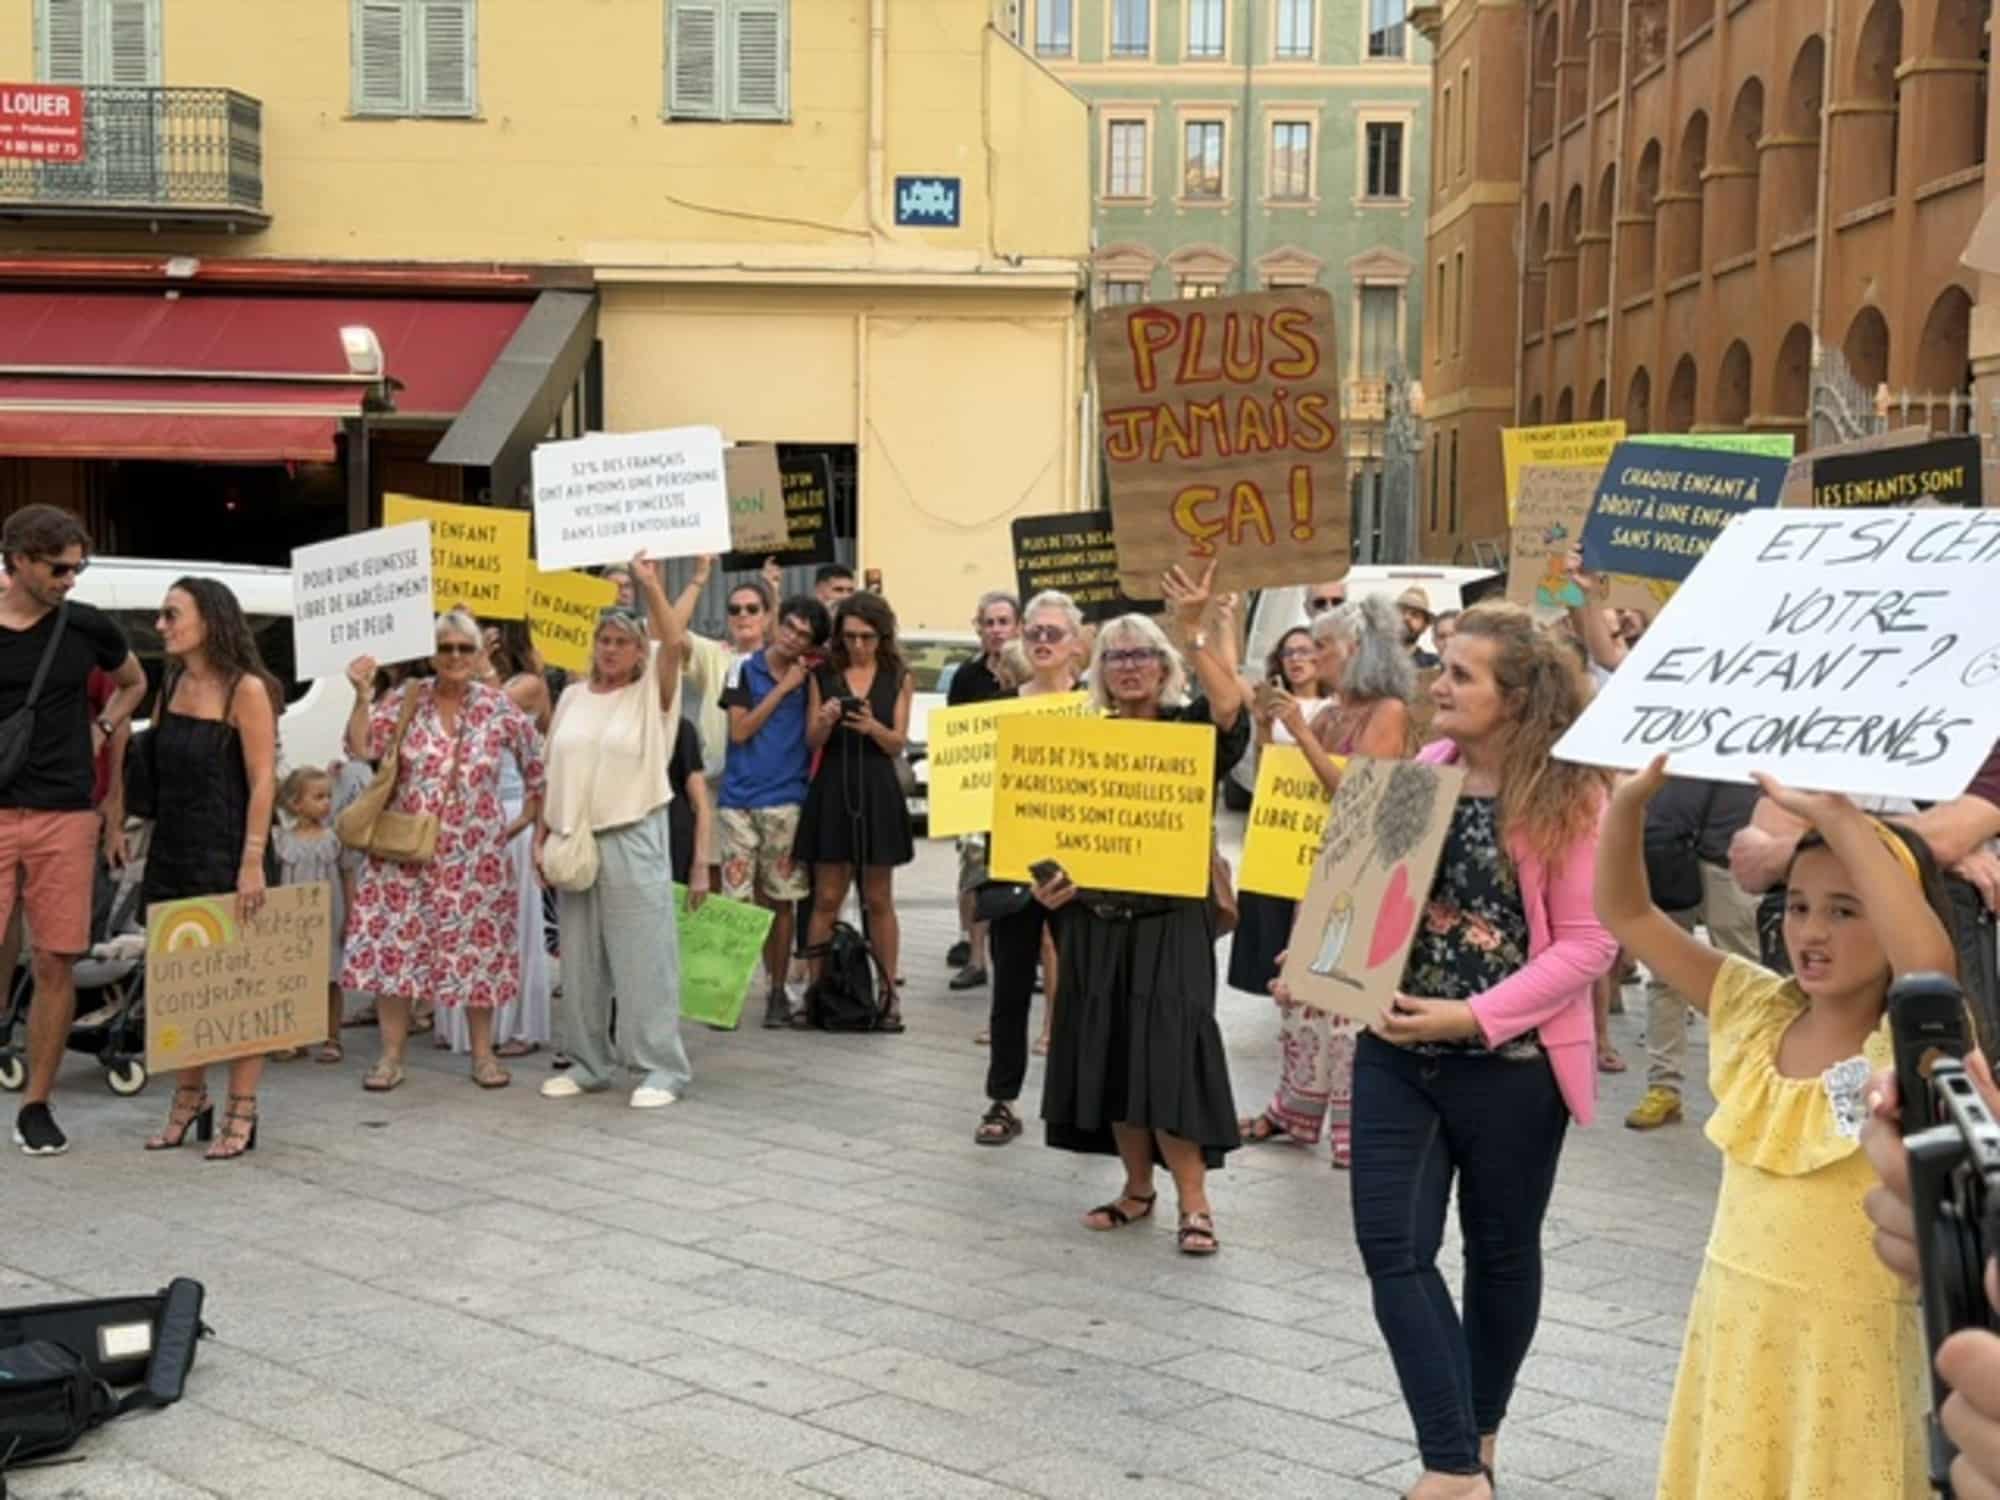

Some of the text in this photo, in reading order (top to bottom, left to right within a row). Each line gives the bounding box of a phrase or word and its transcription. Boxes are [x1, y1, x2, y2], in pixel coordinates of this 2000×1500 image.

[3, 92, 70, 117] LOUER
[1127, 305, 1320, 393] PLUS
[626, 451, 686, 471] FRANÇAIS
[587, 477, 625, 494] MOINS
[655, 469, 718, 487] PERSONNE
[1621, 466, 1683, 492] CHAQUE
[1683, 473, 1746, 501] ENFANT
[1744, 476, 1760, 502] À
[1814, 466, 1965, 508] LES ENFANTS SONT
[1170, 480, 1277, 557] ÇA
[1597, 493, 1643, 518] DROIT
[1643, 494, 1657, 521] À
[1658, 502, 1690, 525] UNE
[440, 520, 497, 545] ENFANT
[561, 512, 702, 542] DANS LEUR ENTOURAGE
[1610, 527, 1651, 549] SANS
[1756, 520, 1844, 563] ET
[302, 548, 419, 590] POUR UNE JEUNESSE
[447, 548, 502, 574] JAMAIS
[329, 593, 344, 614] DE
[1767, 586, 1950, 636] VOTRE
[330, 611, 395, 645] ET DE PEUR
[1643, 640, 1903, 692] ENFANT
[946, 718, 970, 738] UN
[1622, 705, 1974, 767] TOUS CONCERNÉS
[1012, 744, 1045, 766] PLUS
[1049, 746, 1066, 767] DE
[1103, 751, 1131, 772] DES
[1133, 753, 1198, 777] AFFAIRES
[1001, 772, 1207, 805] D'AGRESSIONS SEXUELLES SUR
[1271, 776, 1320, 802] POUR
[1015, 802, 1185, 832] MINEURS SONT CLASSÉES
[1253, 807, 1323, 835] LIBRE DE
[1055, 831, 1092, 853] SANS
[1093, 837, 1133, 856] SUITE
[1297, 843, 1320, 867] ET
[193, 999, 298, 1049] AVENIR
